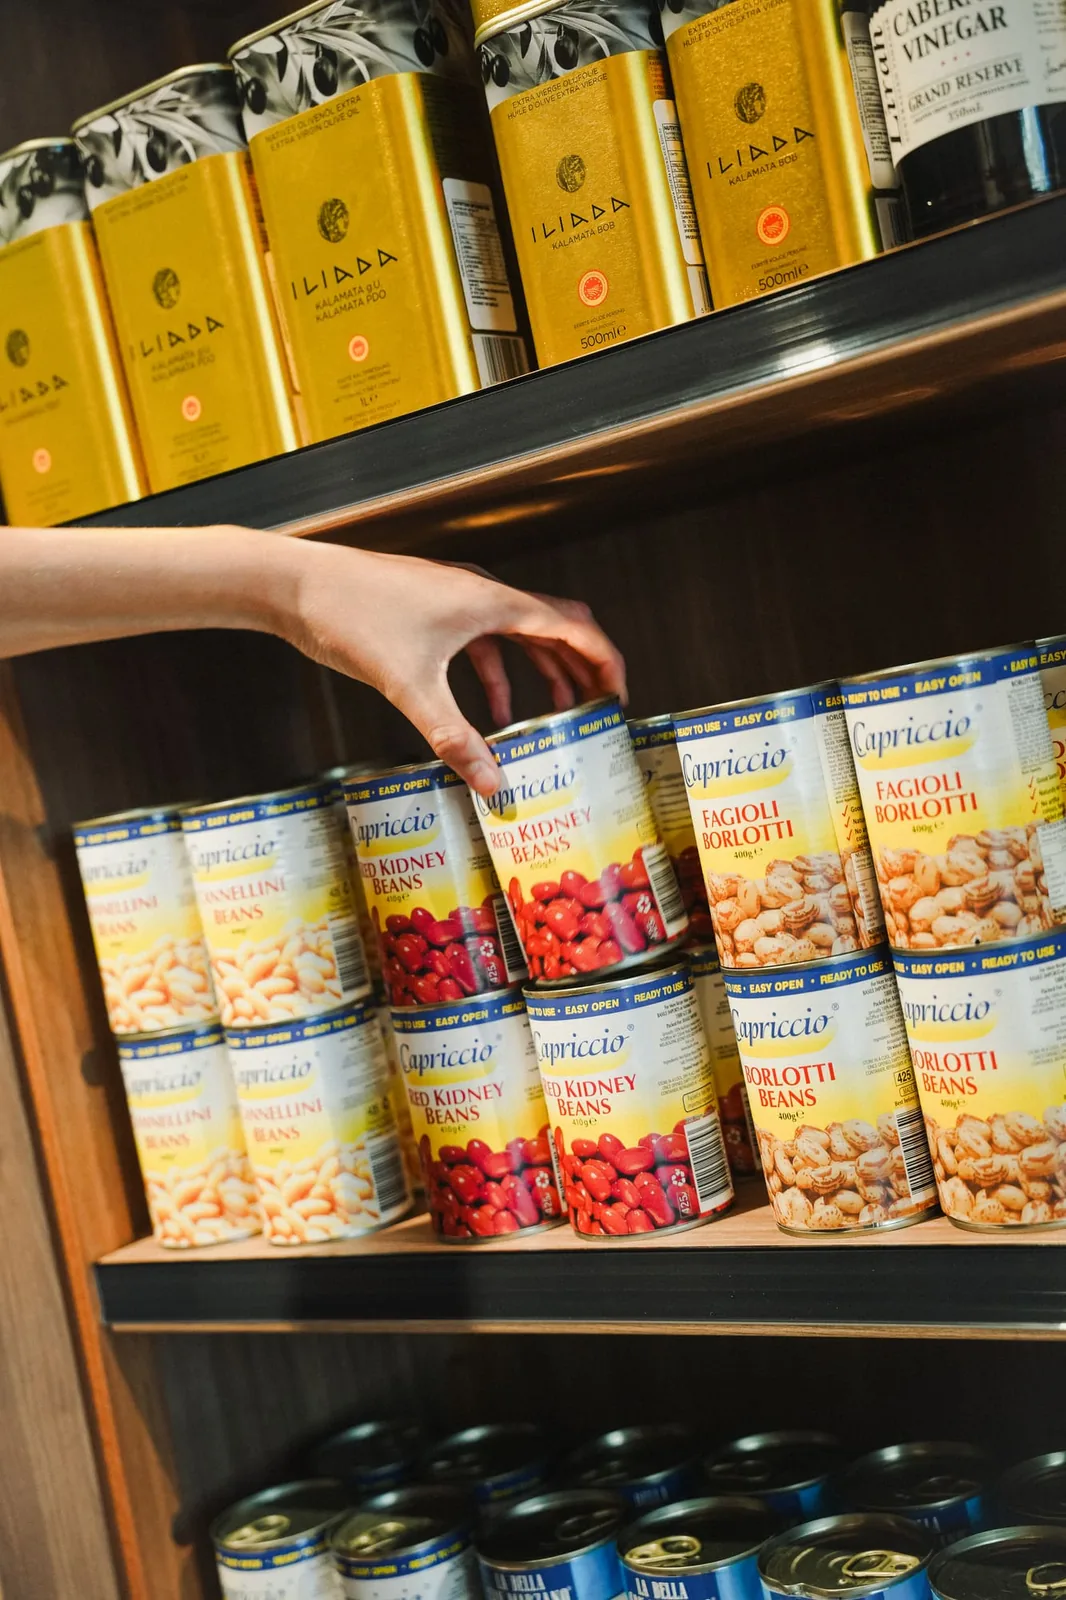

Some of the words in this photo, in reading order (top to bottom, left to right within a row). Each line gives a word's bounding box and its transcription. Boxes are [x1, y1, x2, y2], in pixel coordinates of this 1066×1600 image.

[683, 34, 703, 48] HUILE
[687, 20, 712, 36] EXTRA
[902, 6, 1009, 63] VINEGAR
[507, 107, 526, 120] HUILE
[556, 86, 580, 100] EXTRA
[582, 72, 608, 88] VIERGE
[512, 95, 535, 109] EXTRA
[536, 83, 561, 98] VIERGE
[908, 81, 951, 113] GRAND
[955, 57, 1023, 91] RESERVE
[336, 95, 361, 111] EXTRA
[706, 127, 815, 179] ILIADA
[729, 163, 776, 186] KALAMATA
[531, 197, 630, 243] ILIADA
[552, 228, 596, 250] KALAMATA
[597, 221, 615, 234] BOB
[291, 249, 398, 301] ILIADA
[315, 285, 365, 311] KALAMATA
[315, 299, 365, 323] KALAMATA
[366, 289, 387, 305] PDO
[868, 690, 879, 701] TO
[880, 686, 900, 699] USE
[915, 678, 945, 693] EASY
[948, 671, 982, 686] OPEN
[693, 724, 704, 735] TO
[704, 721, 721, 733] USE
[734, 713, 763, 727] EASY
[765, 706, 796, 721] OPEN
[853, 709, 971, 758] Capriccio
[510, 743, 536, 760] EASY
[538, 731, 566, 750] OPEN
[632, 736, 647, 747] ASY
[683, 742, 791, 788] Capriccio
[378, 784, 401, 796] EASY
[403, 778, 430, 791] OPEN
[876, 771, 963, 801] FAGIOLI
[702, 800, 780, 829] FAGIOLI
[875, 792, 978, 824] BORLOTTI
[489, 830, 515, 850] RED
[518, 806, 591, 842] KIDNEY
[702, 819, 794, 850] BORLOTTI
[379, 850, 446, 877] KIDNEY
[511, 835, 571, 865] BEANS
[373, 873, 423, 896] BEANS
[911, 963, 933, 975] EASY
[935, 961, 965, 974] OPEN
[982, 954, 1019, 969] READY
[1021, 951, 1035, 963] TO
[1036, 945, 1056, 958] USE
[750, 982, 773, 994] EASY
[774, 978, 804, 991] OPEN
[820, 970, 852, 985] READY
[855, 967, 866, 977] TO
[868, 961, 884, 974] USE
[565, 1003, 588, 1015] EASY
[592, 998, 620, 1011] OPEN
[634, 988, 661, 1003] READY
[662, 985, 672, 995] TO
[673, 981, 685, 992] USE
[435, 1014, 459, 1027] EASY
[461, 1009, 489, 1023] OPEN
[731, 1007, 834, 1047] Capriccio
[400, 1038, 498, 1076] Capriccio
[533, 1028, 630, 1066] Capriccio
[565, 1074, 637, 1099] KIDNEY
[744, 1061, 836, 1086] BORLOTTI
[897, 1069, 912, 1083] 425
[922, 1072, 978, 1095] BEANS
[434, 1081, 505, 1107] KIDNEY
[557, 1098, 612, 1117] BEANS
[758, 1088, 817, 1108] BEANS
[425, 1105, 480, 1125] BEANS
[635, 1577, 650, 1598] LA
[651, 1581, 689, 1600] BELLA
